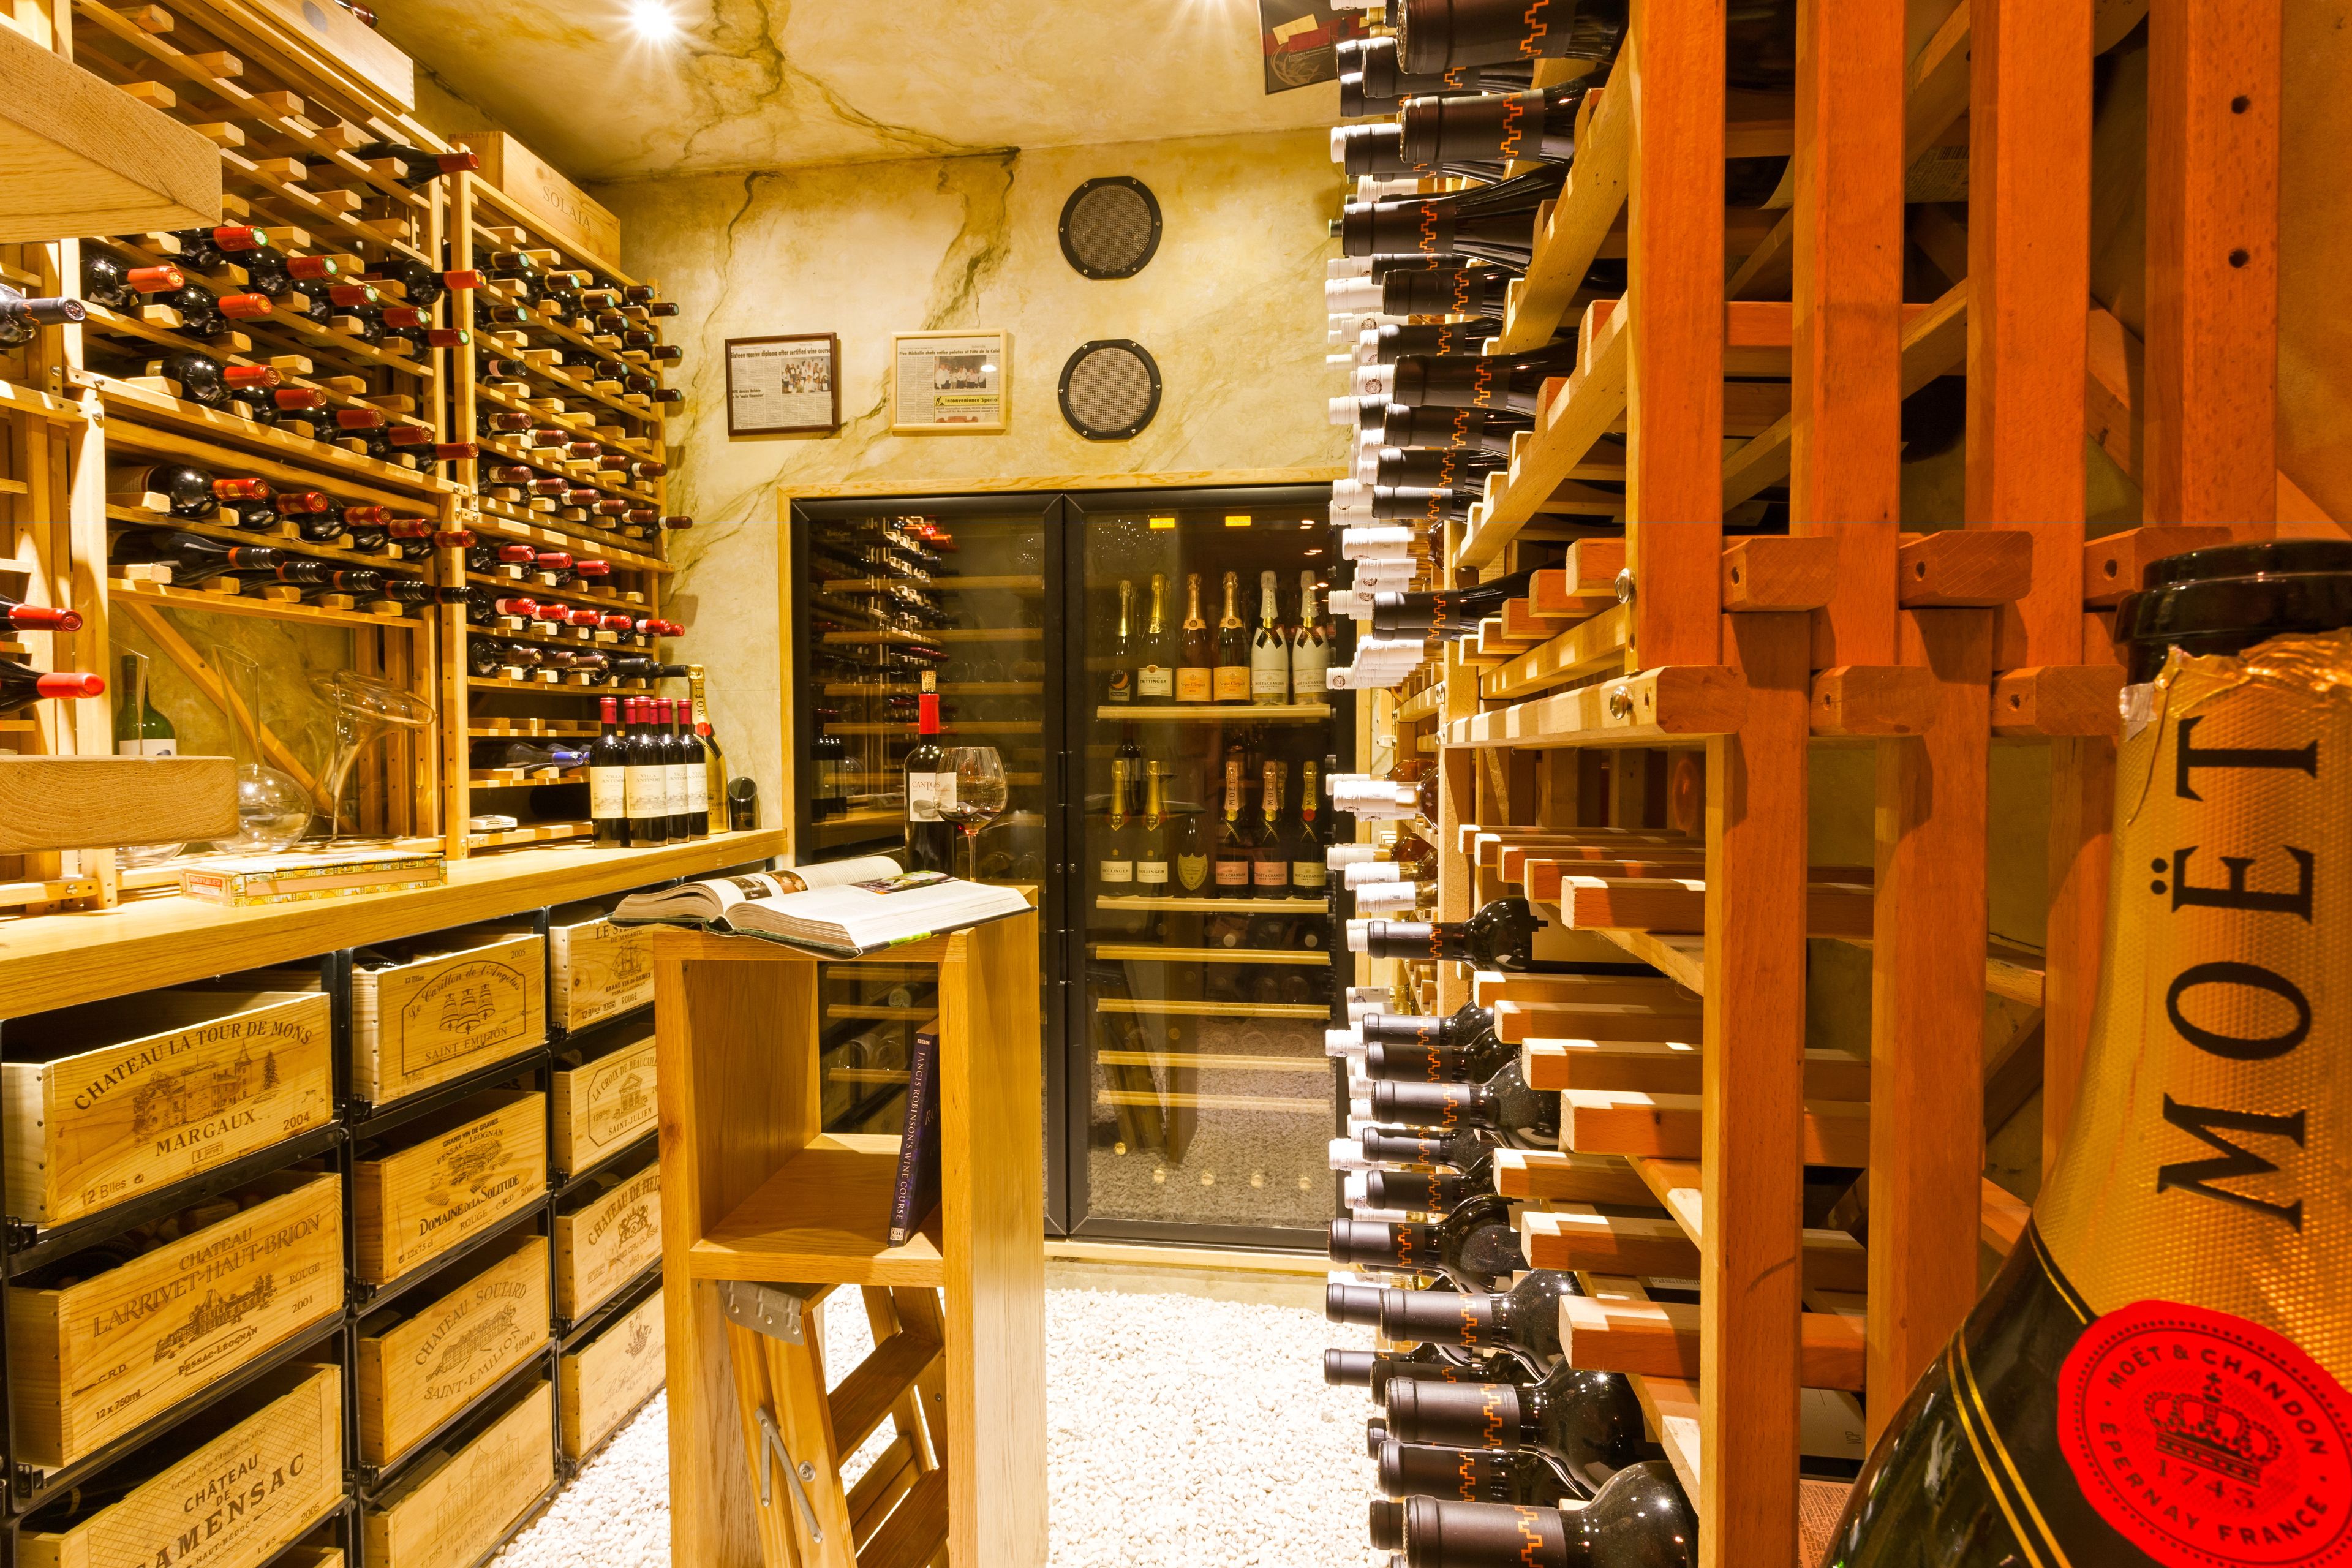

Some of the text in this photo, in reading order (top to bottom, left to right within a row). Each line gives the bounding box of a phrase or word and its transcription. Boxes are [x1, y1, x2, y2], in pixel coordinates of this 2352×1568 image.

[543, 186, 591, 232] SOLAIA
[912, 780, 941, 791] CANTOS
[595, 925, 609, 940] LE
[619, 929, 644, 942] MALARTIC
[510, 948, 526, 959] 2005
[421, 973, 462, 1003] Carillon
[466, 965, 477, 977] de
[480, 963, 521, 990] l'Angelus
[605, 982, 621, 992] GRAND
[636, 972, 651, 982] GRAVES
[2150, 715, 2318, 1234] MOËT
[621, 992, 638, 1005] ROUGE
[425, 1027, 508, 1061] SAINT EMILION
[74, 1020, 312, 1110] CHATEAU LA TOUR DE MONS
[592, 1088, 601, 1102] LA
[601, 1068, 619, 1091] CROIX
[620, 1063, 628, 1076] DE
[914, 1051, 925, 1087] JANCIS
[155, 1109, 256, 1156] MARGAUX
[282, 1111, 311, 1131] 2004
[442, 1134, 462, 1147] GRAND
[462, 1129, 471, 1138] VIN
[479, 1118, 499, 1131] GRAVES
[608, 1107, 652, 1136] SAINT-JULIEN
[906, 1089, 920, 1148] ROBINSON'S
[437, 1129, 504, 1165] PESSAC LEOGNAN
[902, 1151, 911, 1178] WINE
[80, 1191, 95, 1206] 12
[419, 1204, 464, 1237] DOMAINE
[481, 1174, 520, 1203] SOLITUDE
[460, 1209, 488, 1231] ROUGE
[521, 1183, 535, 1197] 2001
[587, 1183, 641, 1246] CHATEAU DE
[895, 1180, 907, 1219] COURSE
[178, 1227, 253, 1272] CHATEAU
[407, 1238, 434, 1259] 12x75 cl
[92, 1214, 321, 1338] LARRIVET-HAUT-BRION
[288, 1262, 321, 1285] ROUGE
[291, 1295, 314, 1314] 2001
[415, 1281, 527, 1366] CHATEAU SOUTARD
[514, 1330, 537, 1353] 1990
[97, 1363, 129, 1384] C.R.D.
[424, 1326, 521, 1400] SAINT-EMILION
[95, 1408, 106, 1420] 12
[115, 1389, 141, 1409] 750ml
[2106, 1344, 2330, 1457] MOËT & CHANDON
[184, 1453, 258, 1513] CHÂTEAU
[216, 1489, 230, 1507] DE
[301, 1502, 320, 1525] 2005
[454, 1503, 505, 1559] MARGAUX
